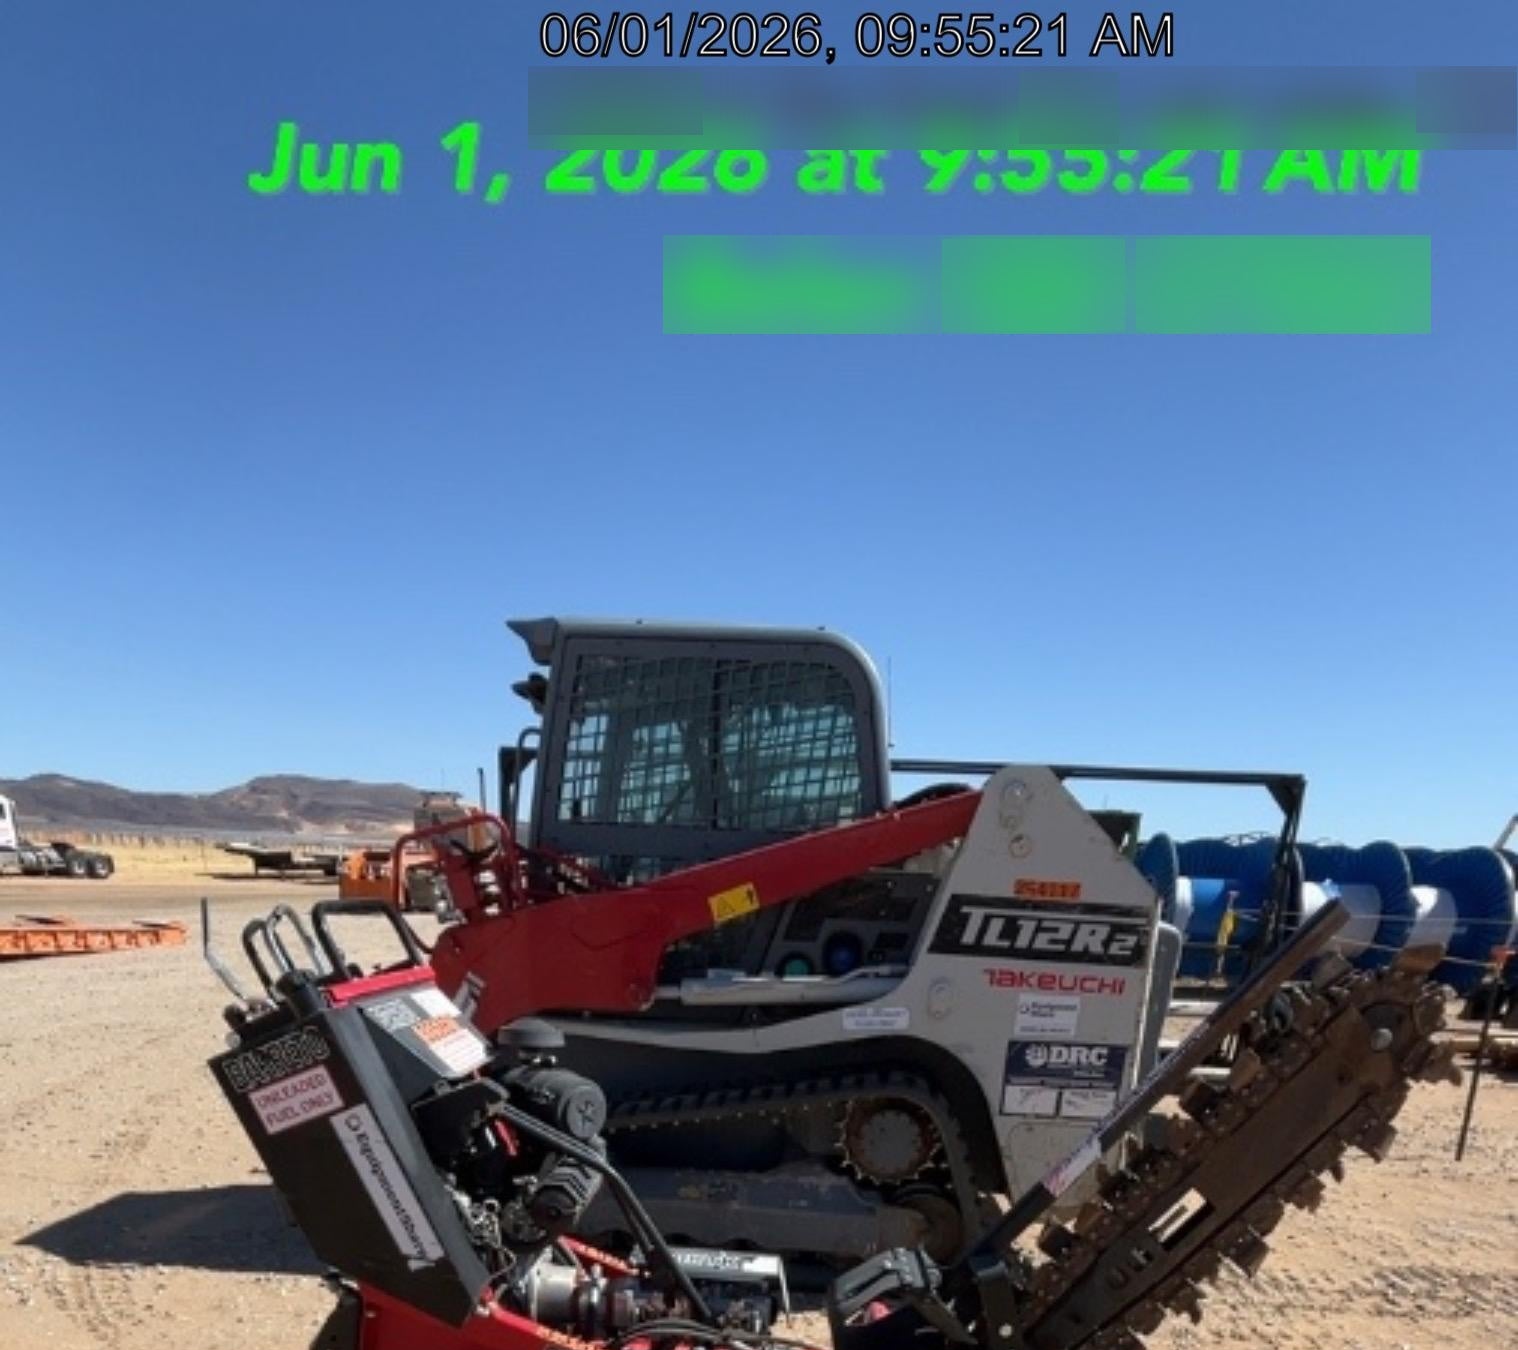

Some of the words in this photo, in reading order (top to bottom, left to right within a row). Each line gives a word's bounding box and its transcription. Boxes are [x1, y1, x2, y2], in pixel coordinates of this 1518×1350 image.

[1048, 1045, 1109, 1066] DRC
[256, 1073, 327, 1108] UNLEADED
[265, 1106, 300, 1127] FUEL
[300, 1091, 334, 1113] ONLY
